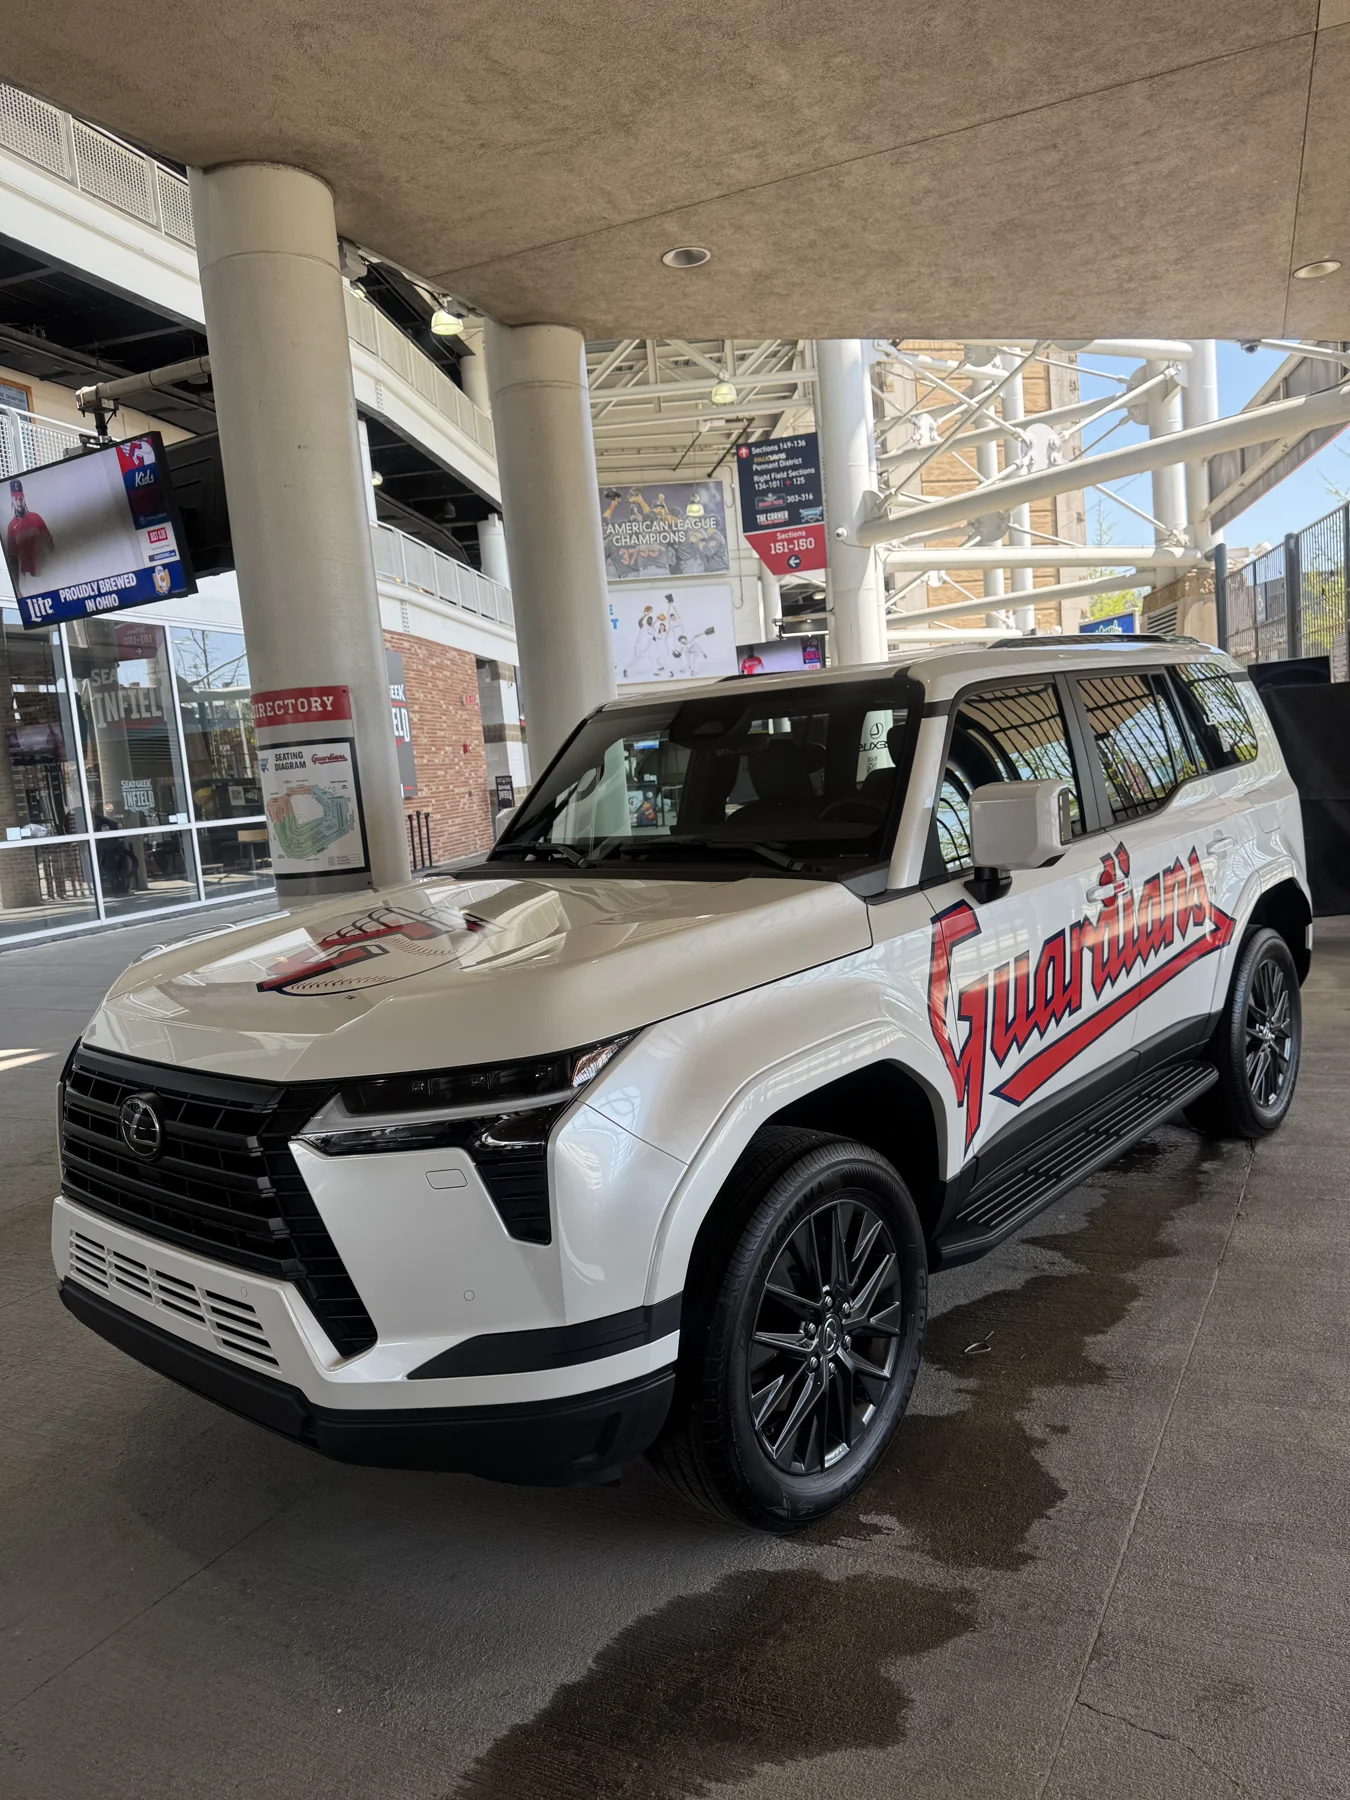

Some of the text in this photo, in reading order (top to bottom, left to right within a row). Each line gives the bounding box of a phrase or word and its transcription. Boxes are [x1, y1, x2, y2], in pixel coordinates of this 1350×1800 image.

[751, 439, 806, 454] Sections 149-136
[752, 457, 802, 471] Pennant District
[135, 469, 155, 487] Kids
[753, 467, 815, 484] Right Field Sections
[754, 476, 805, 490] 134-101 125
[786, 492, 814, 503] 303-316
[756, 513, 767, 524] THE
[766, 510, 789, 522] CORNER
[606, 517, 717, 535] AMERICAN LEAGUE
[612, 531, 686, 547] CHAMPIONS
[776, 530, 807, 540] Sections
[769, 537, 815, 554] 151-150
[618, 548, 638, 565] 37
[58, 573, 137, 602] PROUDLY BREWED
[26, 597, 55, 623] Lite
[85, 593, 119, 613] IN OHIO
[251, 695, 334, 719] DIRECTORY
[274, 751, 349, 765] SEATING Guardians
[274, 760, 307, 771] DIAGRAM
[121, 778, 153, 789] SEATGEEK
[122, 790, 155, 810] INFIELD
[927, 841, 1237, 1159] Guardians
